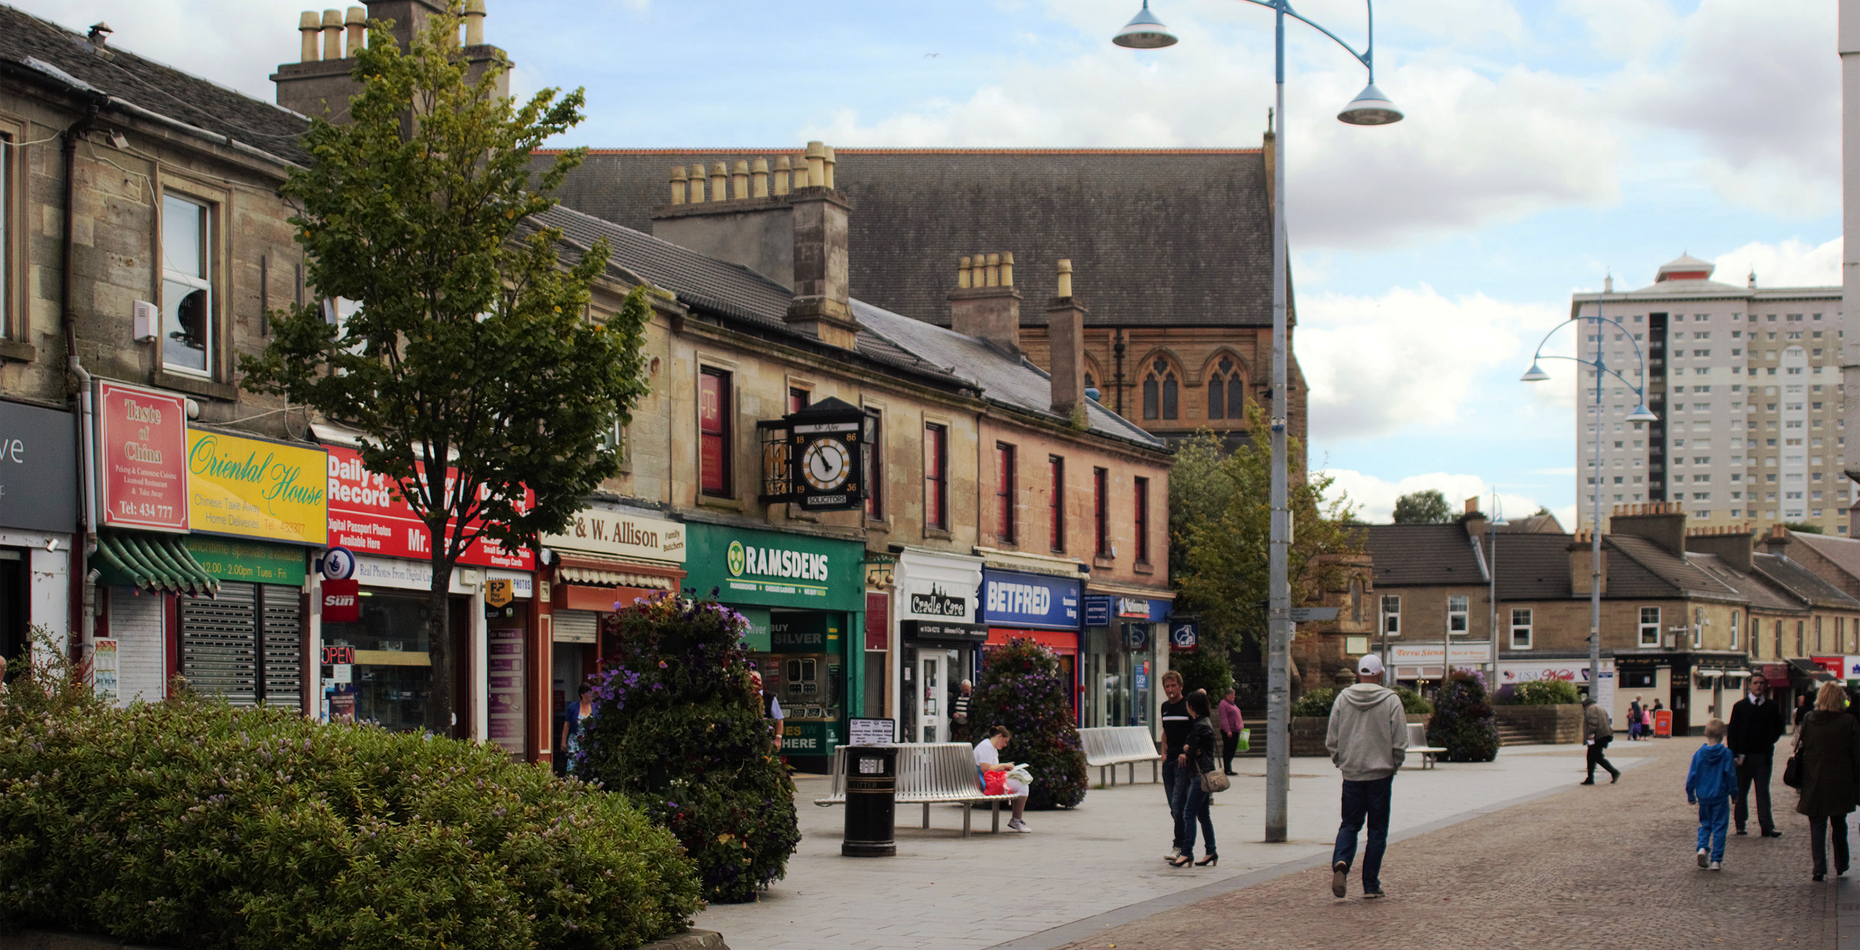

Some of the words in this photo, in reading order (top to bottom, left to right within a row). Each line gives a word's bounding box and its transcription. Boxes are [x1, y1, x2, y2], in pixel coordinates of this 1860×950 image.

[124, 398, 161, 424] Taste
[138, 426, 150, 440] of
[796, 436, 804, 444] 18
[846, 433, 856, 441] 86
[124, 441, 162, 464] China
[190, 435, 274, 483] Oriental
[329, 455, 370, 487] Daily
[144, 479, 167, 488] Restaurant
[262, 463, 323, 516] House
[139, 488, 150, 496] Take
[151, 490, 163, 499] Away
[329, 478, 390, 507] Record
[809, 496, 846, 504] SOLICITORS
[119, 501, 137, 515] Tel:
[139, 503, 156, 517] 434
[158, 505, 173, 518] 777
[195, 494, 222, 509] Chinese
[224, 498, 241, 511] Take
[242, 501, 260, 517] Away
[206, 512, 226, 526] Home
[228, 514, 260, 529] Deliveries
[328, 518, 346, 532] Digital
[347, 520, 372, 535] Passport
[373, 523, 391, 537] Photos
[408, 528, 429, 553] Mr.
[576, 516, 587, 538] &
[591, 519, 608, 541] W.
[613, 521, 658, 548] Allison
[665, 530, 680, 540] Family
[184, 538, 228, 555] Lunchtime
[232, 544, 266, 559] specials
[269, 548, 302, 562] available
[340, 534, 366, 548] Available
[367, 537, 380, 549] Here
[664, 542, 684, 552] Butchers
[202, 562, 222, 573] 12.00
[228, 564, 253, 578] 2.00pm
[256, 566, 272, 578] Tues
[278, 568, 286, 578] Fri
[746, 546, 828, 581] RAMSDENS
[360, 563, 371, 576] Real
[373, 565, 391, 578] Photos
[392, 567, 405, 580] From
[406, 568, 422, 583] Digital
[513, 579, 530, 589] PHOTOS
[913, 596, 941, 614] Cradle
[944, 599, 963, 615] Care
[987, 581, 1050, 615] BETFRED
[774, 633, 822, 644] SILVER
[323, 647, 354, 664] OPEN
[1421, 649, 1446, 657] Sienn
[1520, 672, 1538, 680] USA
[782, 738, 817, 748] HERE
